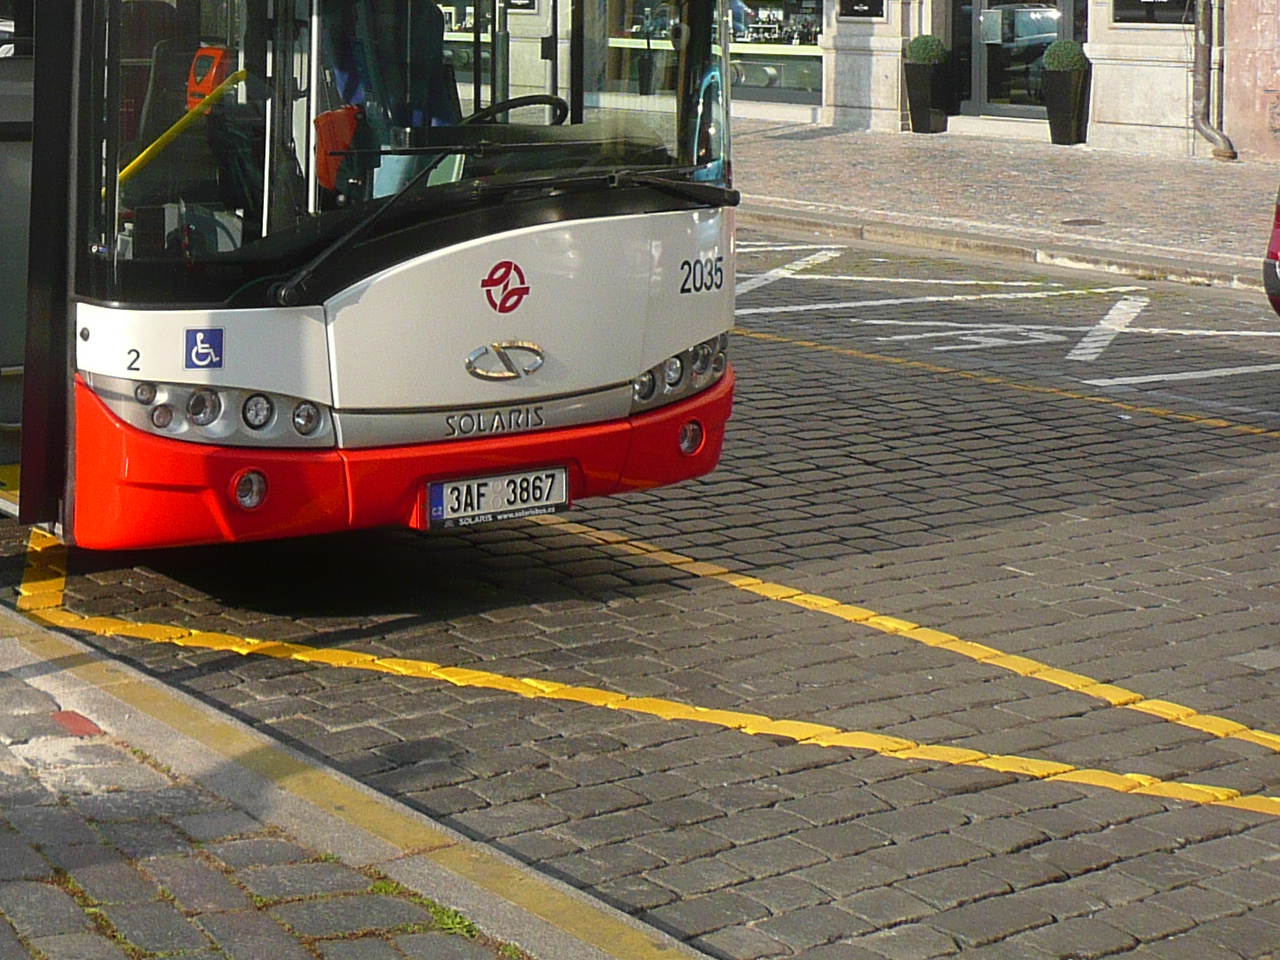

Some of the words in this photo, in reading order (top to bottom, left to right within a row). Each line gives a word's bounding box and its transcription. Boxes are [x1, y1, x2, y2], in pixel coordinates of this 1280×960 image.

[679, 256, 724, 294] 2035
[126, 348, 141, 372] 2
[444, 406, 546, 437] SOLARIS
[448, 482, 488, 513] 3AF
[505, 473, 556, 506] 3867
[431, 507, 443, 516] CZ
[458, 514, 493, 526] SOLARIS
